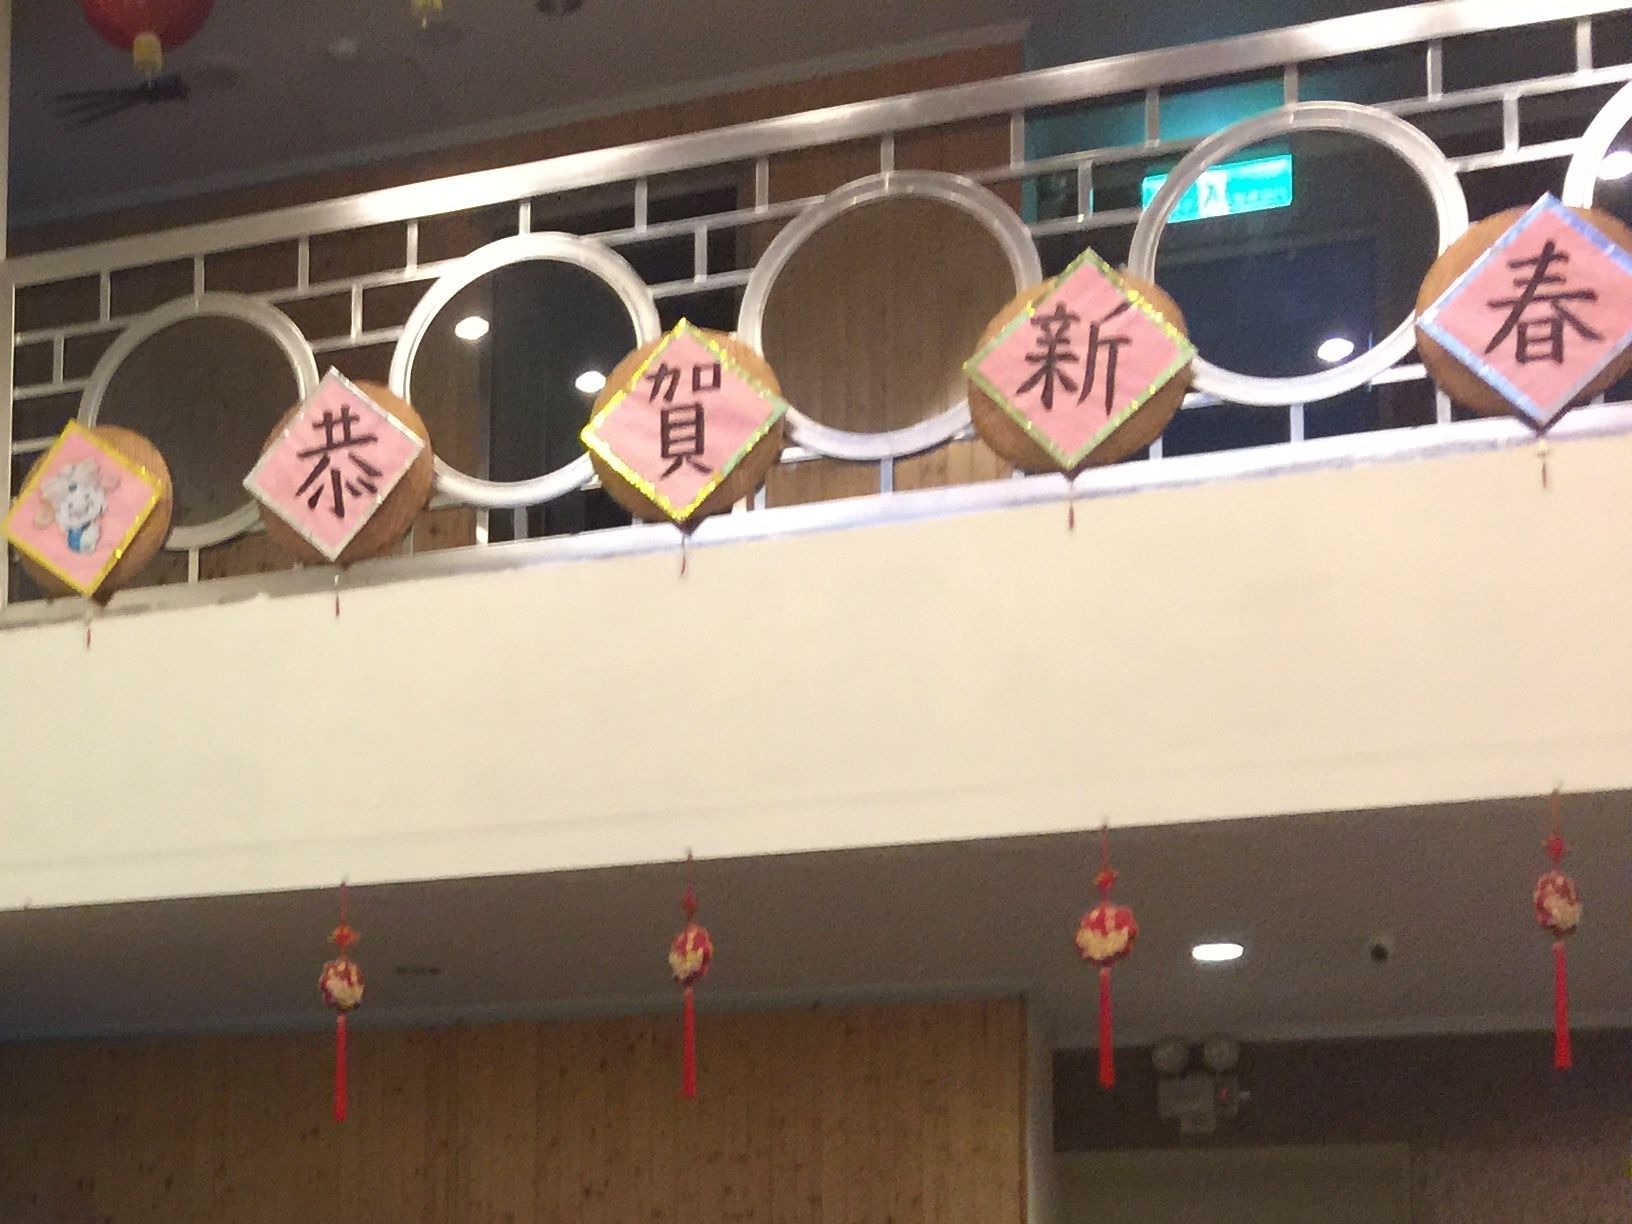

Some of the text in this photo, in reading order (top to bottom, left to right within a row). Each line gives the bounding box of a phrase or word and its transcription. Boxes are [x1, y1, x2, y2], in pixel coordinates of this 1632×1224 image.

[295, 239, 1603, 519] 恭 賀 新 春
